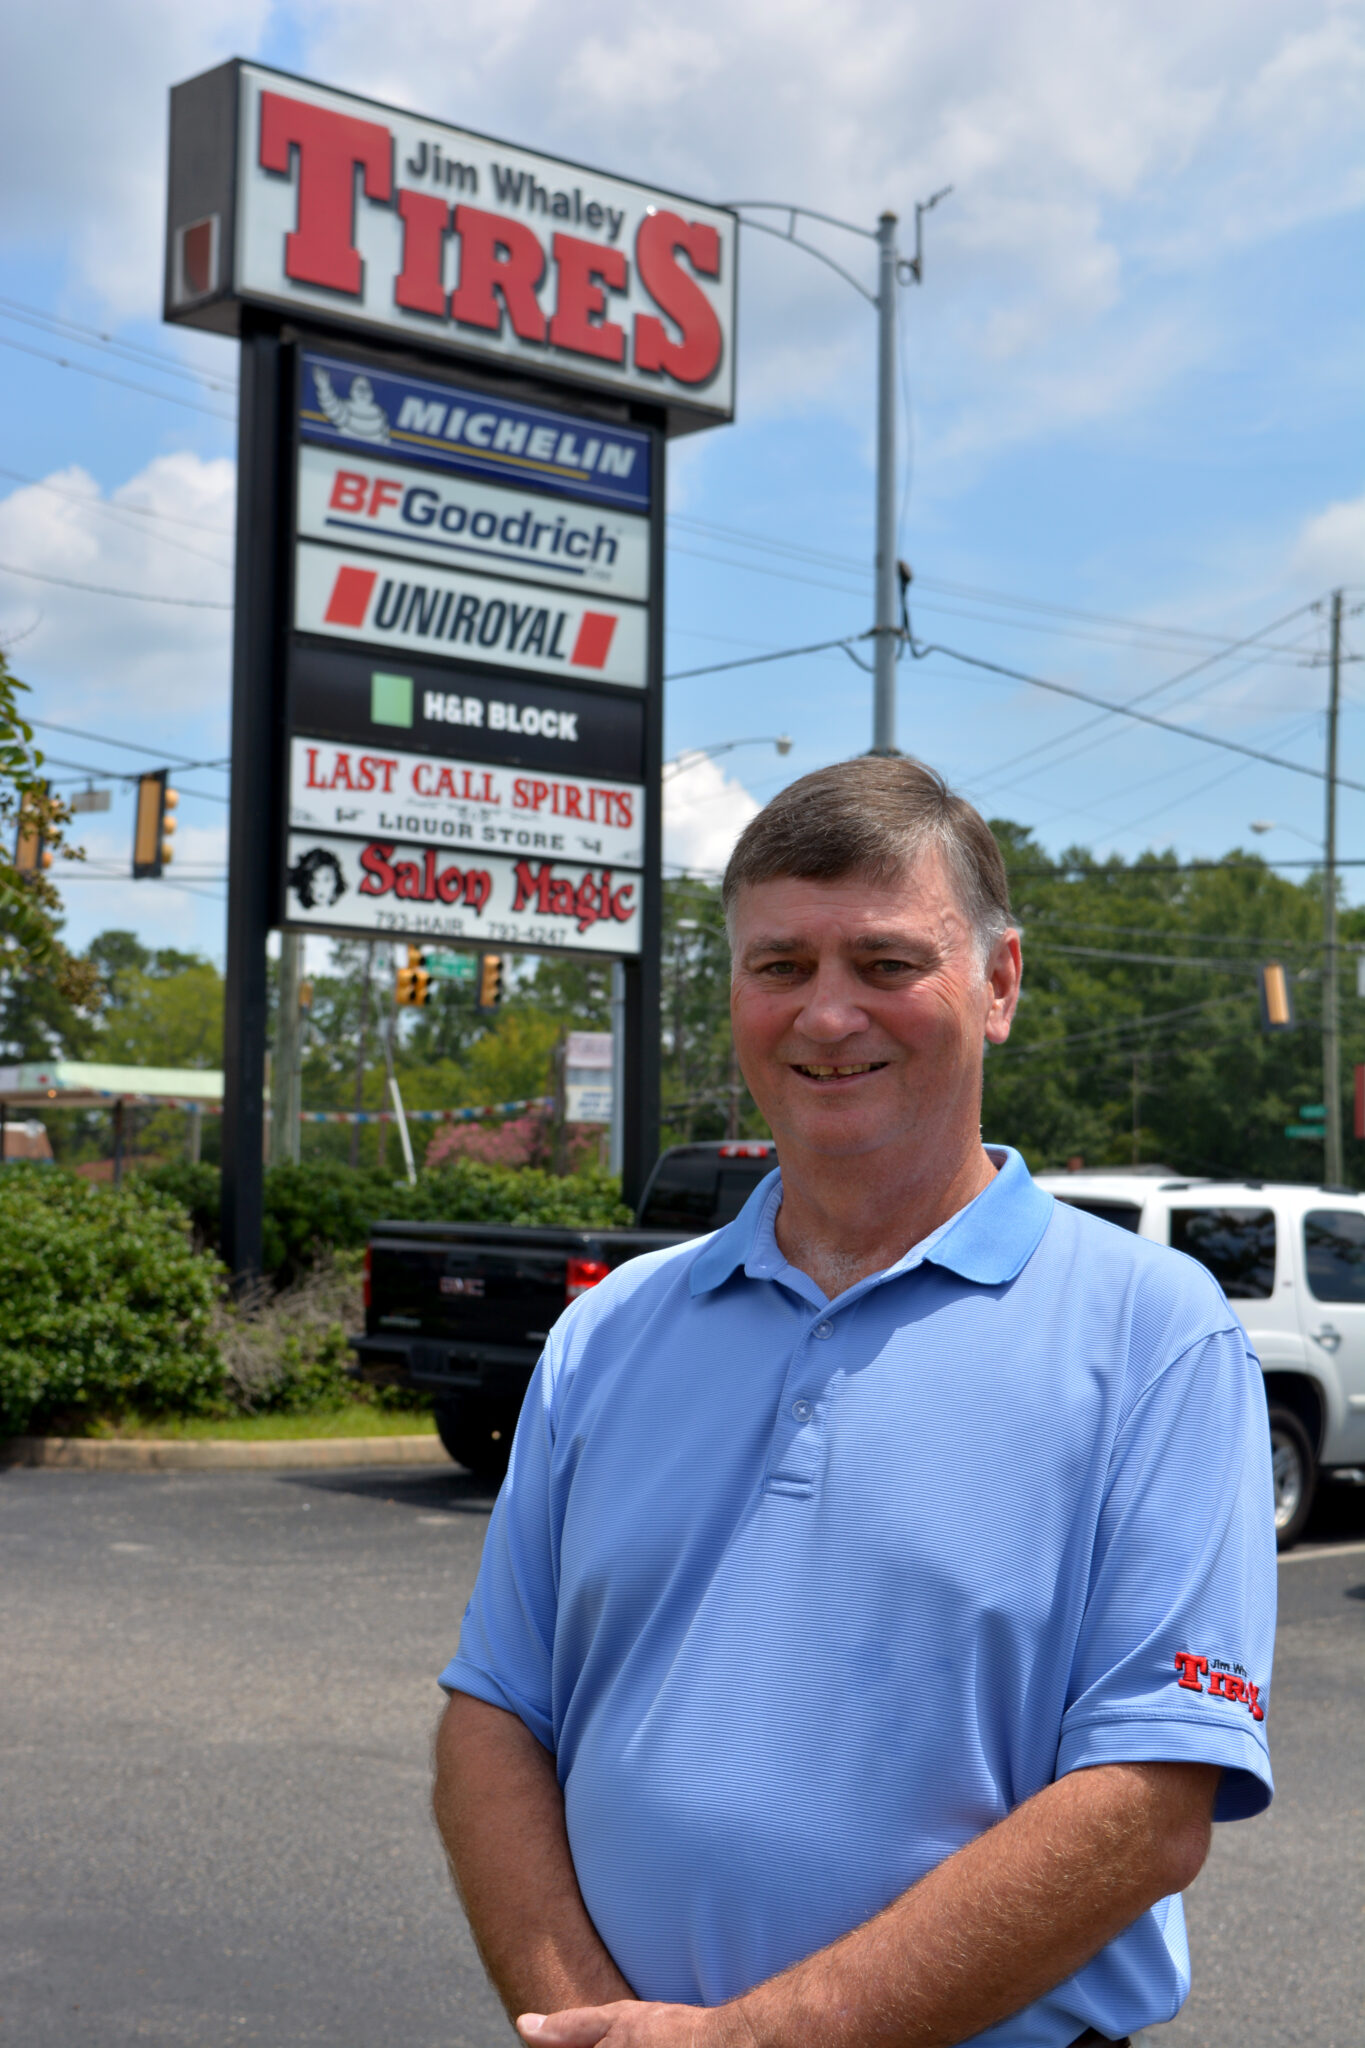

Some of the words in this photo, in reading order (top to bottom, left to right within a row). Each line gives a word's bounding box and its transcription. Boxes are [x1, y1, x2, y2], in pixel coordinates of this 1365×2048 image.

[406, 141, 478, 193] Jim
[491, 163, 626, 241] Whaley
[258, 89, 723, 385] TIRES
[396, 396, 636, 478] MICHELIN
[328, 469, 618, 566] BFGoodrich
[373, 578, 567, 661] UNIROYAL
[423, 691, 485, 727] H&R
[487, 701, 579, 741] BLOCK
[305, 748, 398, 793] LAST
[412, 764, 502, 805] CALL
[512, 778, 634, 829] SPIRITS
[379, 813, 473, 839] LIQUOR
[482, 826, 565, 851] STORE
[358, 842, 493, 917] Salon
[512, 860, 636, 933] Magic
[375, 911, 464, 937] 793-HAIR
